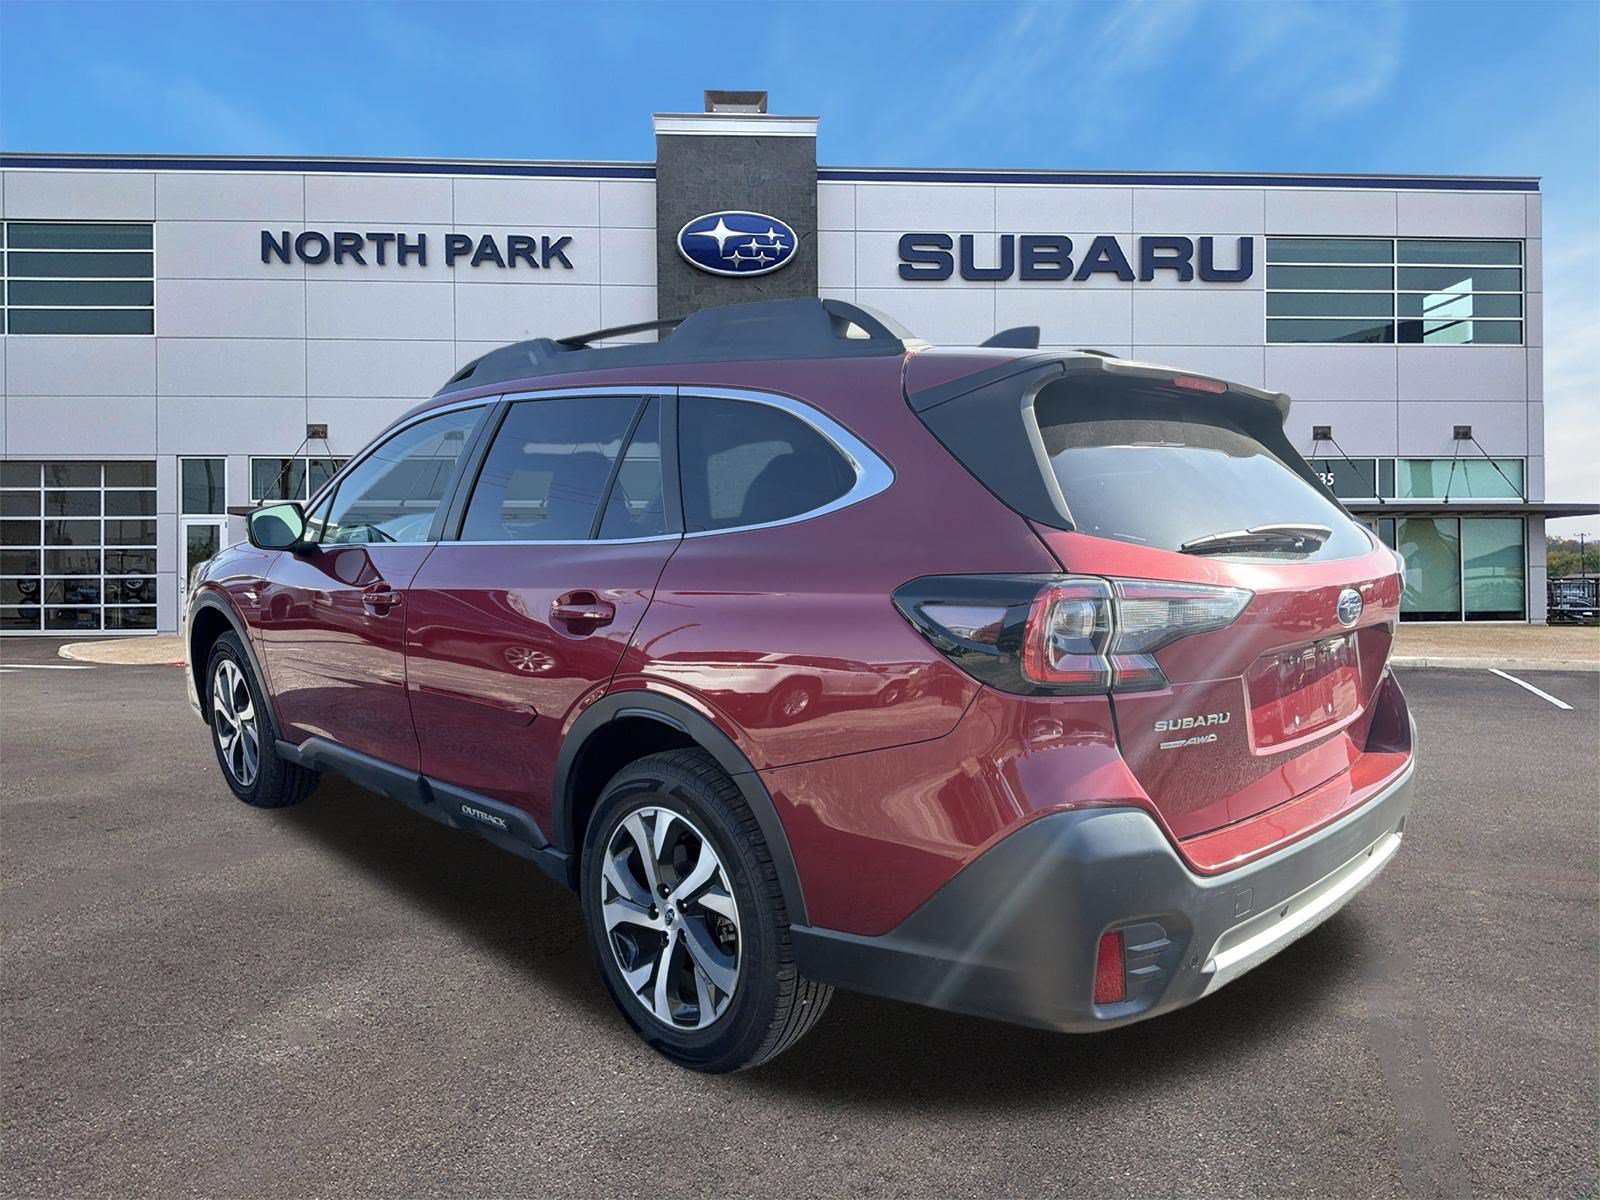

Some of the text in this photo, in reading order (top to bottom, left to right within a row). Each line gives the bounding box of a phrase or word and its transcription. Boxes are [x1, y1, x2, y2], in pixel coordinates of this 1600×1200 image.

[260, 230, 574, 269] NORTH PARK
[898, 233, 1254, 282] SUBARU
[1316, 472, 1335, 486] 35
[1153, 712, 1231, 732] SUBARU
[1184, 733, 1218, 747] AWD
[461, 804, 507, 828] OUTBACK
